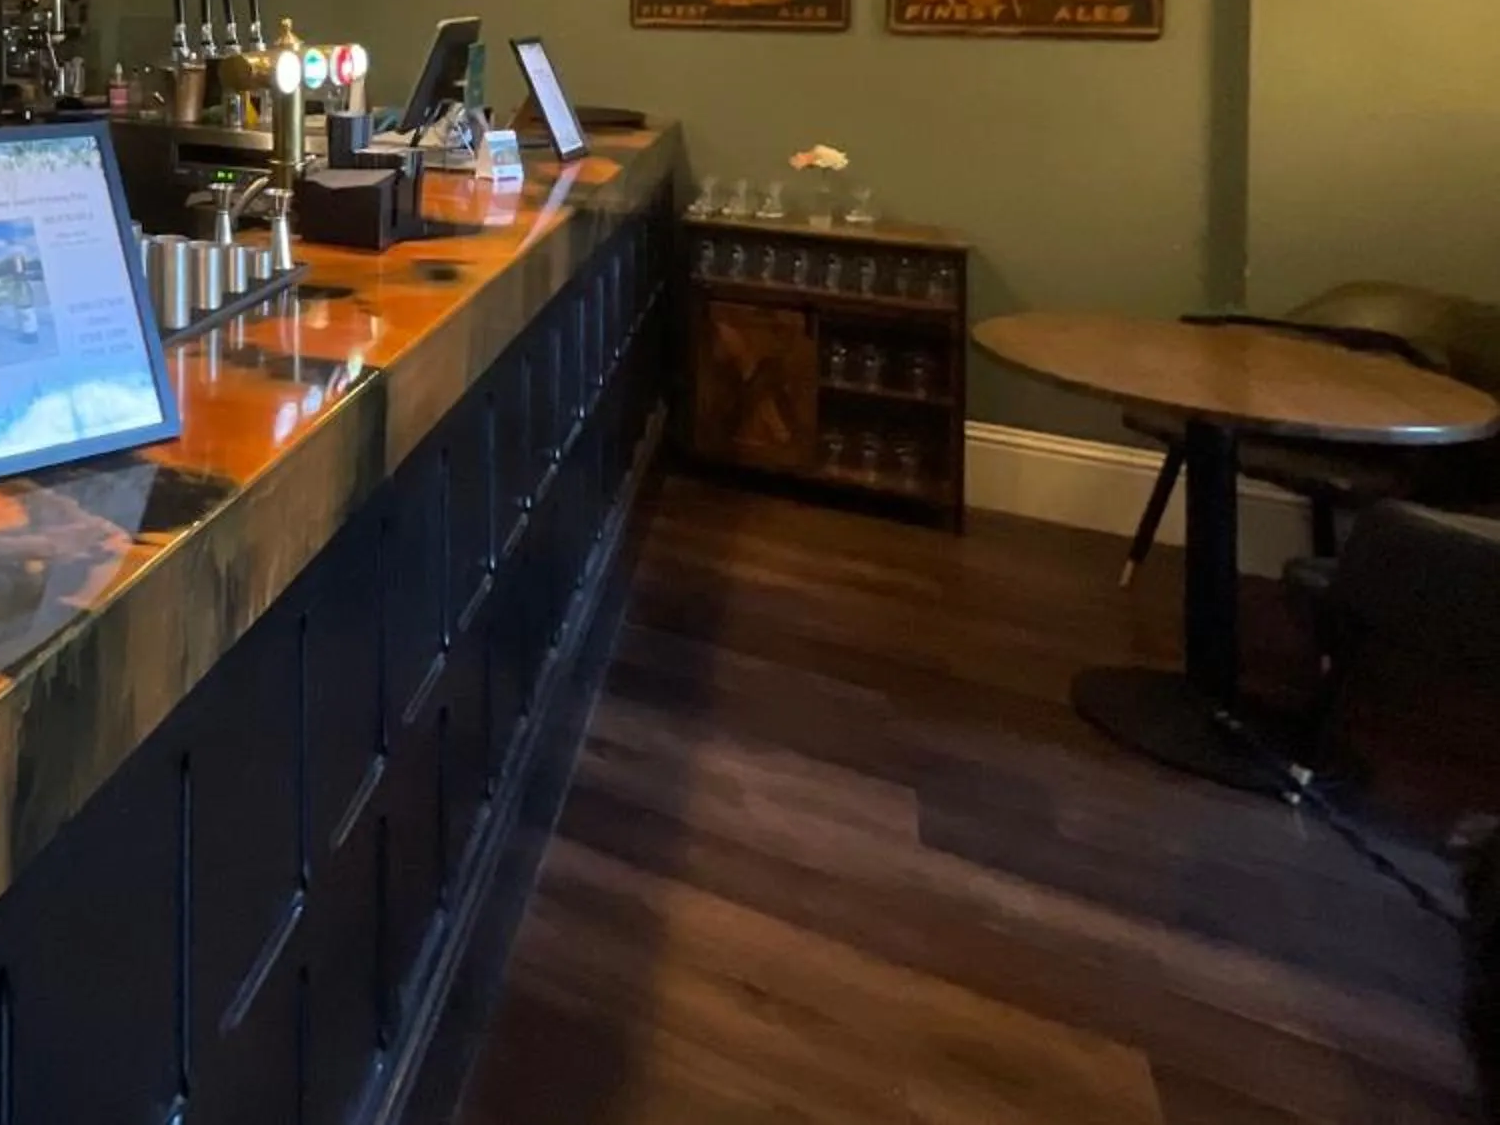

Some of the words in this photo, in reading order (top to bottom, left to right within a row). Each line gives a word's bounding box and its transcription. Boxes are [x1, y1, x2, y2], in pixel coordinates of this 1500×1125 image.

[641, 5, 708, 17] FINEST
[904, 4, 1006, 21] FINEST
[1054, 4, 1132, 23] ALES
